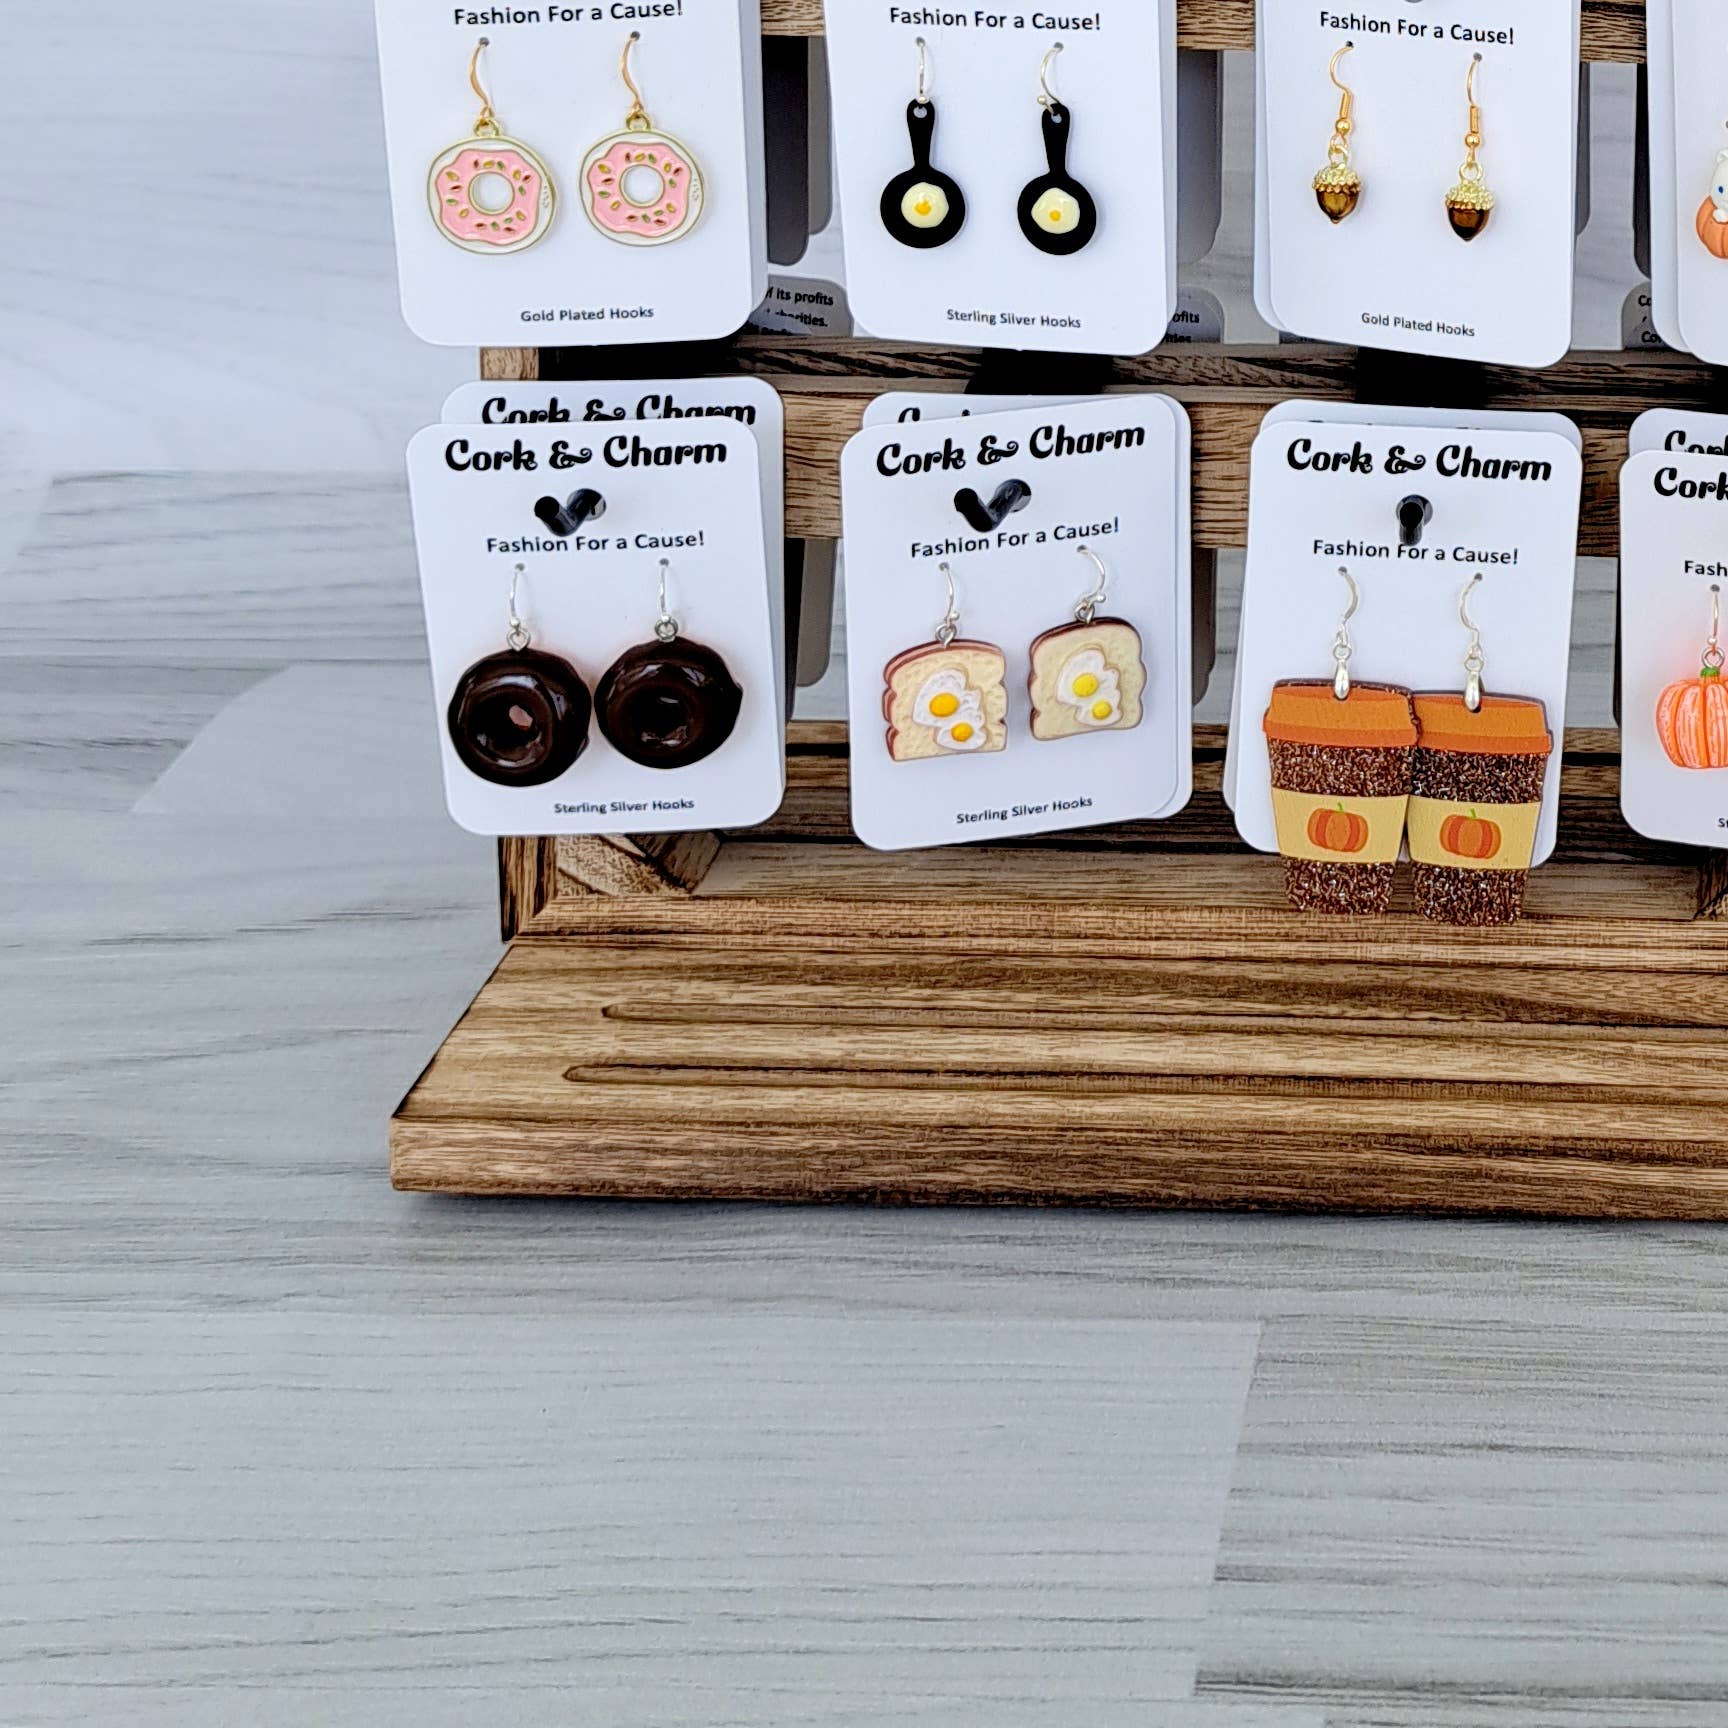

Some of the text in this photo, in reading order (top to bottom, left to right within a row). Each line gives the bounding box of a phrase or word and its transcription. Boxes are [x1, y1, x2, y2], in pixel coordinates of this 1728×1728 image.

[454, 6, 541, 25] Fashion
[548, 5, 584, 23] For
[591, 7, 603, 21] a
[890, 6, 1101, 31] Fashion For a Cause!
[1320, 10, 1514, 45] Fashion For a Cause!
[520, 306, 654, 322] Gold Plated Hooks
[946, 309, 1081, 329] Sterling Silver Hooks
[1361, 312, 1475, 337] Gold Plated Hooks
[444, 435, 727, 472] Cork & Charm
[876, 424, 1146, 477] Cork & Charm
[1286, 438, 1552, 482] Cork & Charm
[486, 530, 705, 553] Fashion For a Cause!
[911, 516, 1119, 559] Fashion For a Cause!
[1313, 539, 1518, 565] Fashion For a Cause!
[554, 799, 695, 815] Sterling Silver Hooks
[956, 796, 1093, 824] Sterling Silver Hooks
